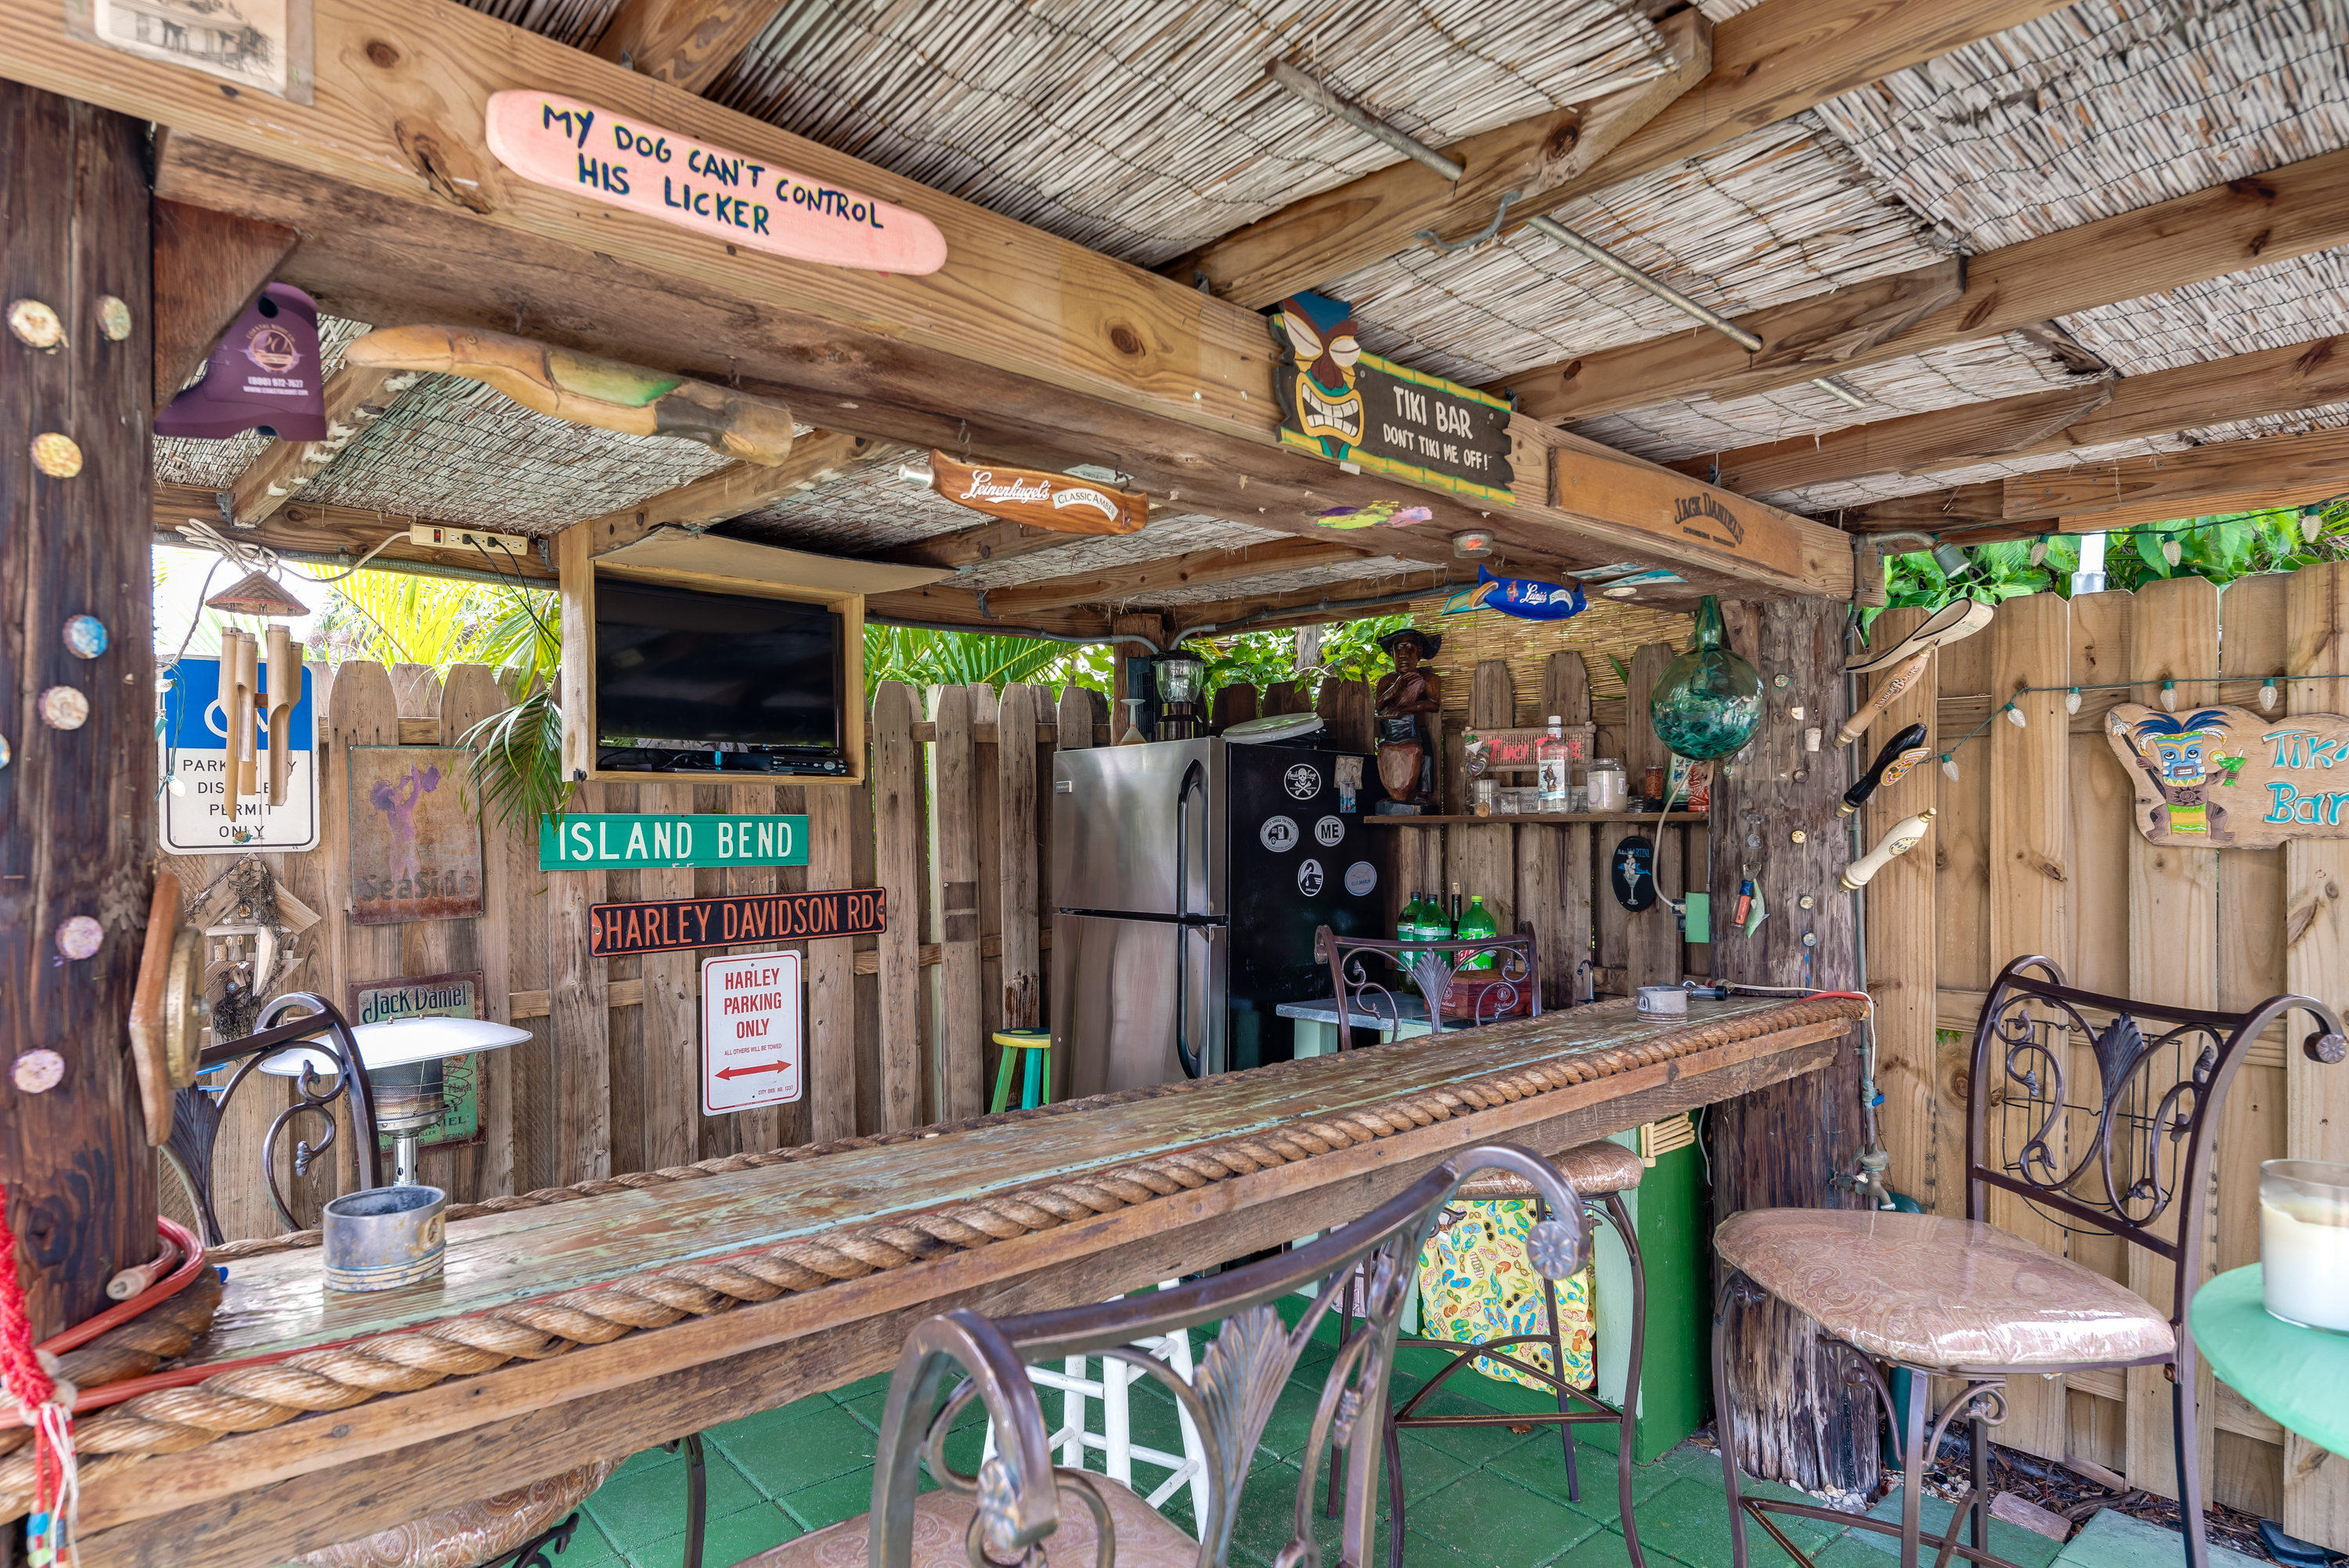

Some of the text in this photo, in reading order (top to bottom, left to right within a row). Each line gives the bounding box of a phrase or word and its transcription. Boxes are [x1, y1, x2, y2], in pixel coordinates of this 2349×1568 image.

[543, 103, 884, 229] MY DOG CAN'T CONTROL
[577, 153, 770, 236] HIS LICKER
[1393, 386, 1474, 440] TIKI BAR
[1383, 423, 1489, 471] DON'T TIKI ME OFF!
[1058, 491, 1117, 517] CLASSIC AMBER
[1674, 496, 1703, 524] JACK
[1874, 683, 1899, 710] AMBER
[1892, 665, 1921, 692] BOCK
[1488, 738, 1527, 761] TIKI
[2263, 781, 2349, 826] Bar
[559, 821, 792, 861] ISLAND BEND
[1321, 824, 1340, 839] ME
[605, 895, 875, 949] HARLEY DAVIDSON RD
[725, 968, 780, 990] HARLEY
[362, 982, 467, 1024] Jack Daniel
[723, 992, 782, 1015] PARKING
[736, 1018, 770, 1039] ONLY
